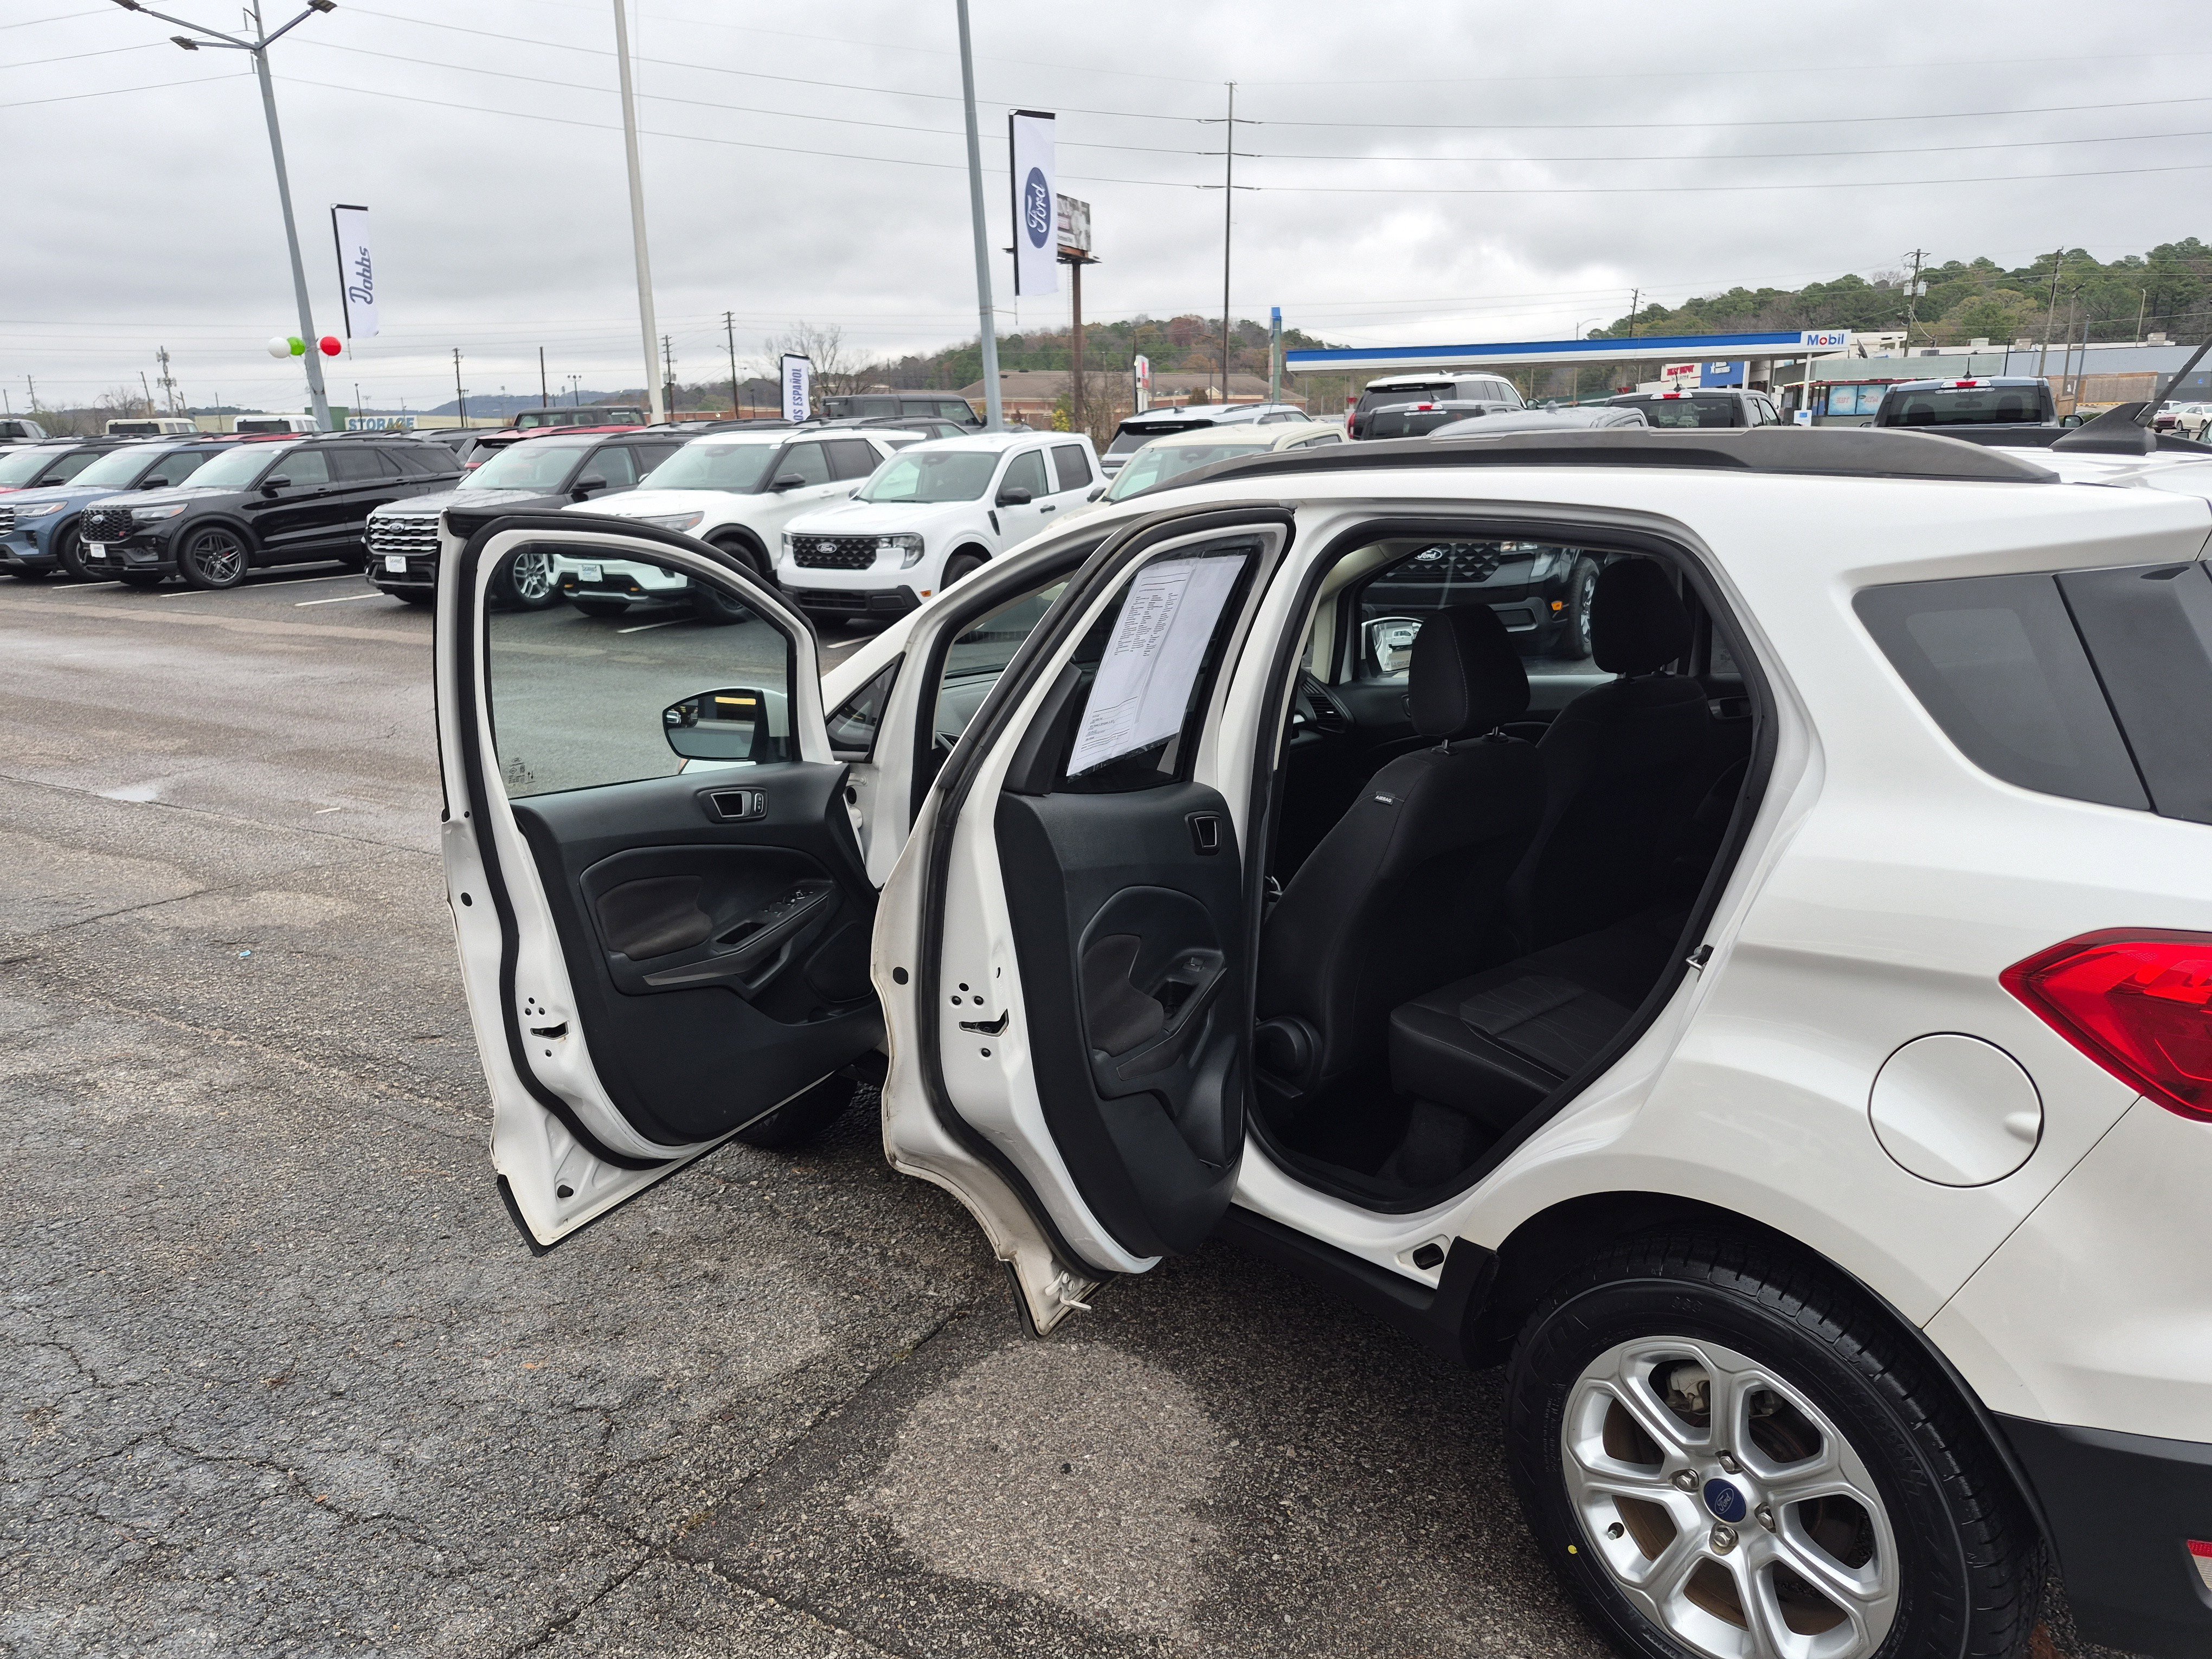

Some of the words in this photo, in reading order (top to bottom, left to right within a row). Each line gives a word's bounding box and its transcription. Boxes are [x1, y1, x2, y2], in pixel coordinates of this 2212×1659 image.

[1027, 183, 1047, 233] Ford
[349, 246, 374, 305] Dobbs
[1807, 333, 1844, 345] Mobil
[789, 369, 803, 406] ESPAÑOL
[349, 417, 414, 430] STORAGE
[1716, 1492, 1732, 1511] Ford
